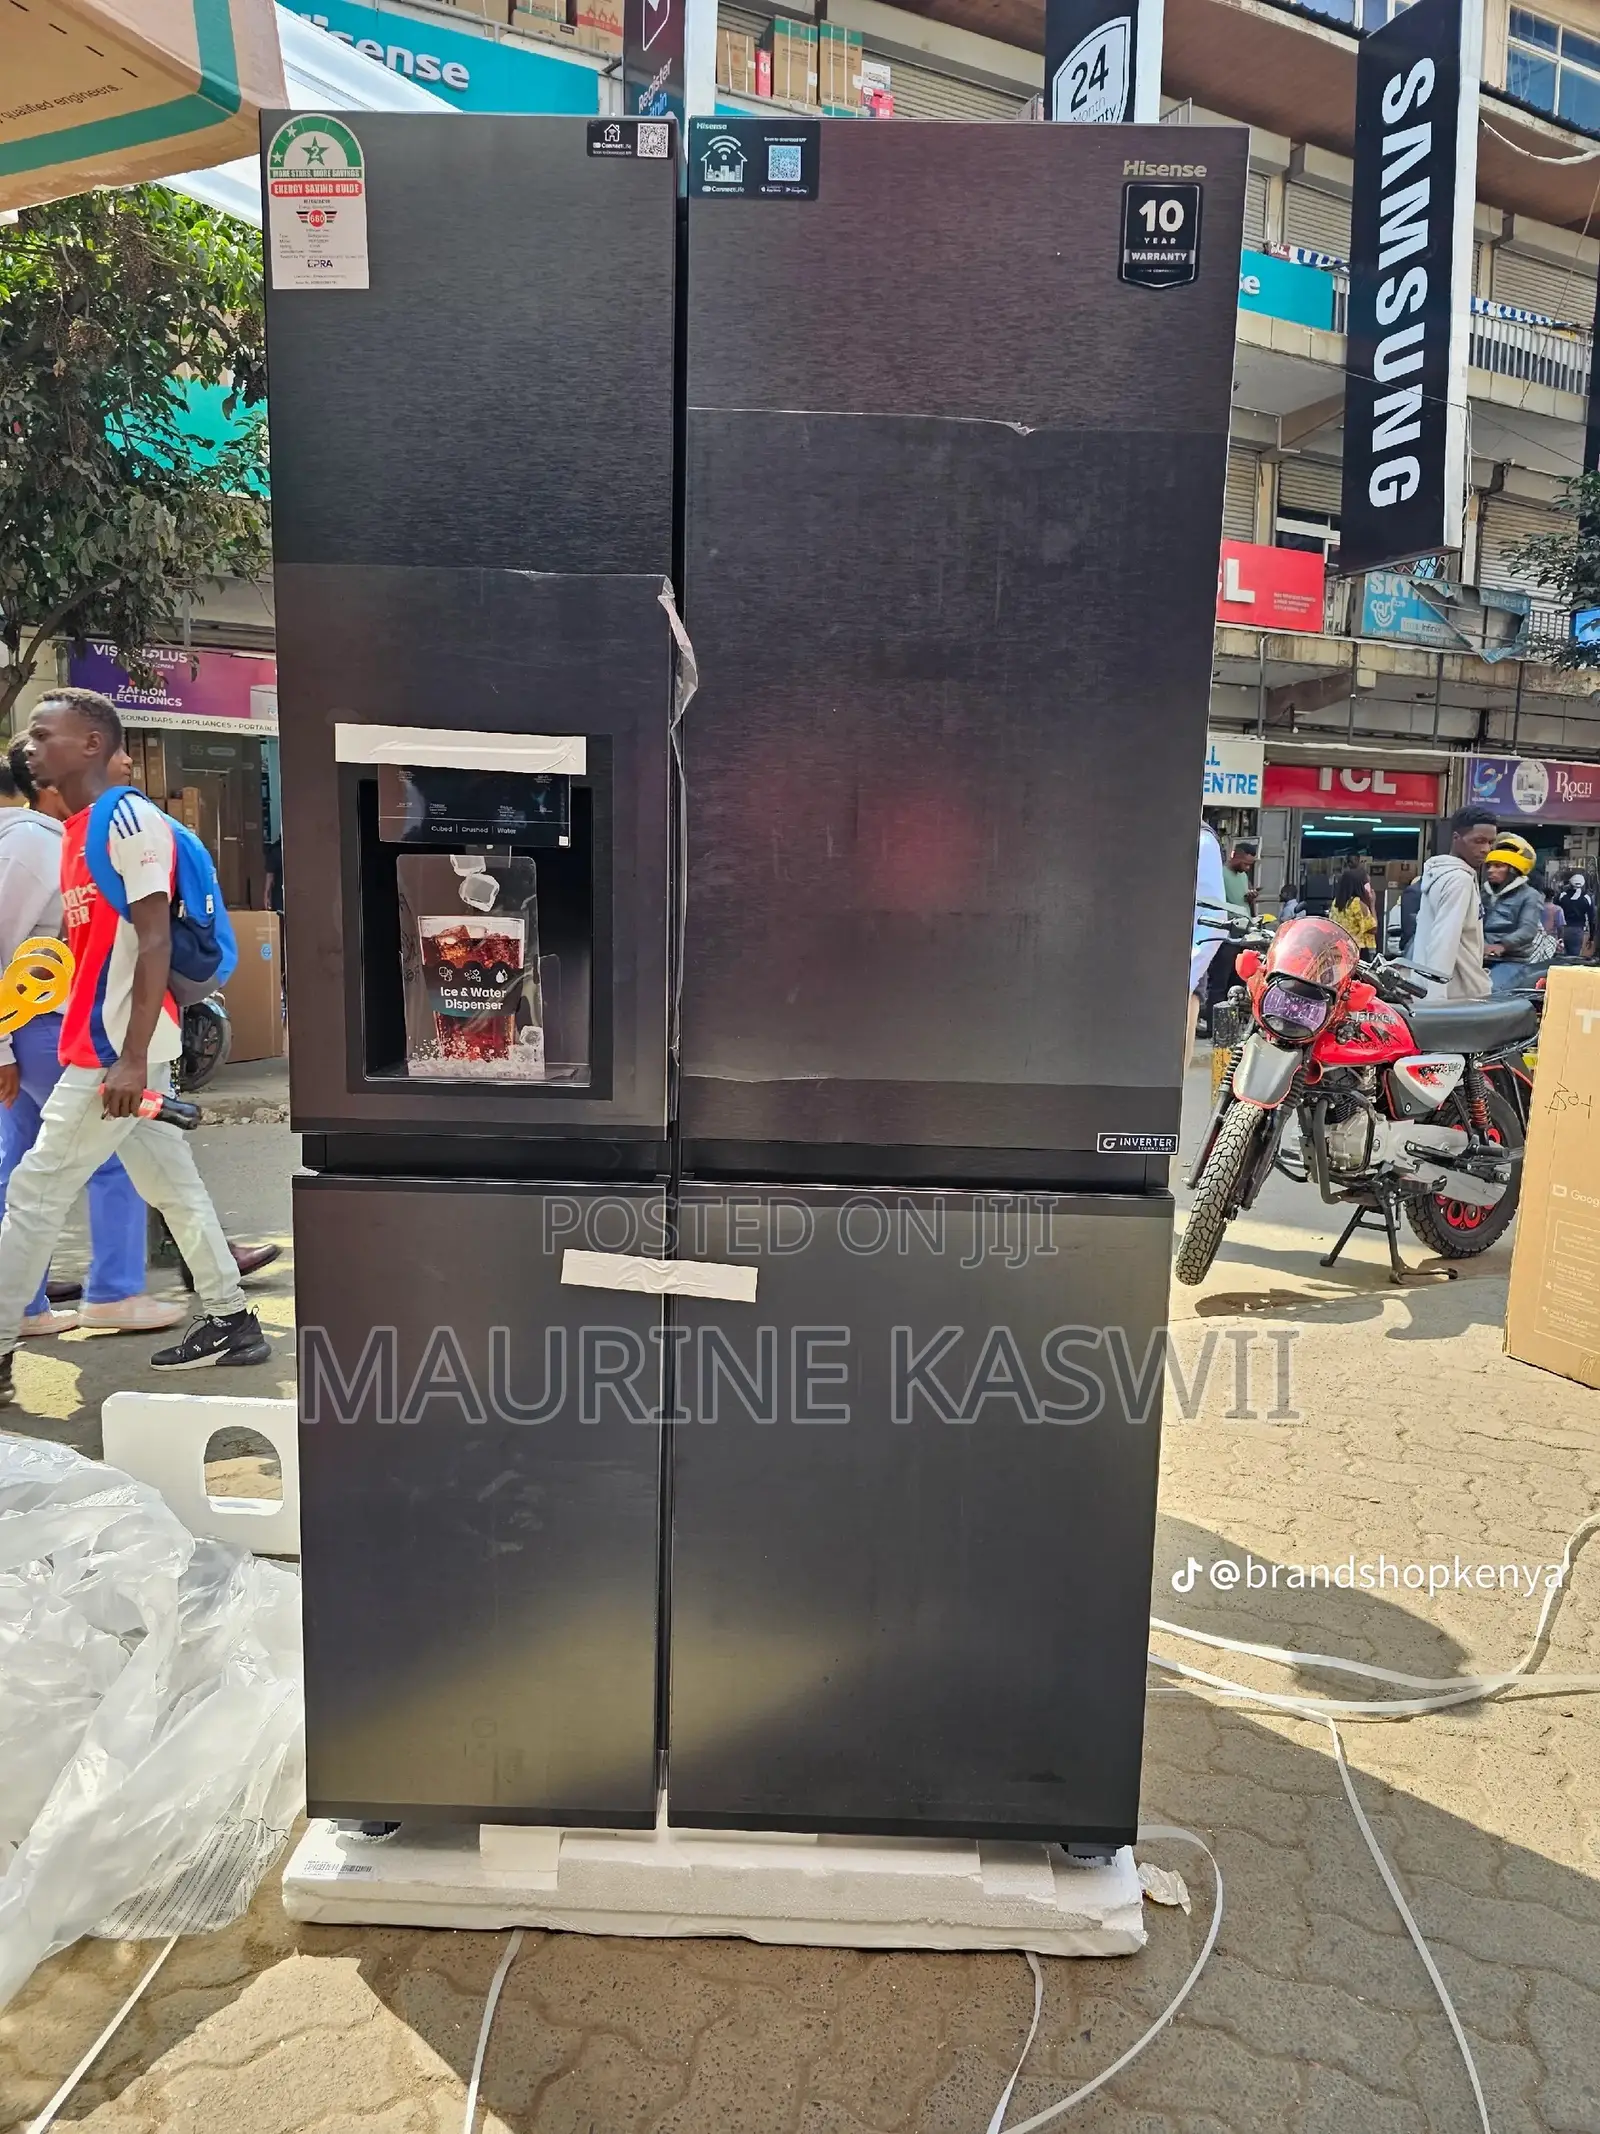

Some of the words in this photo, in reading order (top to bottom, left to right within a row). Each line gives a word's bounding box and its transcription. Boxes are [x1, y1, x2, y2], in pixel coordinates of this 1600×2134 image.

[638, 57, 672, 114] Register
[1071, 44, 1109, 113] 24
[1, 99, 54, 120] qualified
[54, 84, 123, 105] engineers.
[696, 122, 728, 130] Hisense
[311, 146, 320, 159] 2
[1122, 160, 1207, 178] Hisense
[274, 183, 303, 194] ENERGY
[305, 183, 334, 193] SAVING
[335, 183, 359, 193] GUIDE
[1139, 199, 1184, 232] 10
[1131, 252, 1187, 261] WARRANTY
[1368, 57, 1435, 508] SAMSUNG
[102, 692, 183, 707] ELECTRONICS
[120, 714, 149, 722] SOUND
[151, 716, 173, 724] BARS
[181, 719, 232, 729] APPLIANCES
[1555, 771, 1592, 802] ROCH
[431, 825, 453, 833] Cubed
[461, 826, 489, 834] Crushed
[497, 827, 517, 835] Water
[440, 986, 459, 997] Ice
[460, 987, 468, 997] &
[470, 987, 506, 998] Water
[445, 998, 503, 1011] Dispenser
[1119, 1137, 1172, 1147] INVERTER
[1571, 1189, 1600, 1208] Goog
